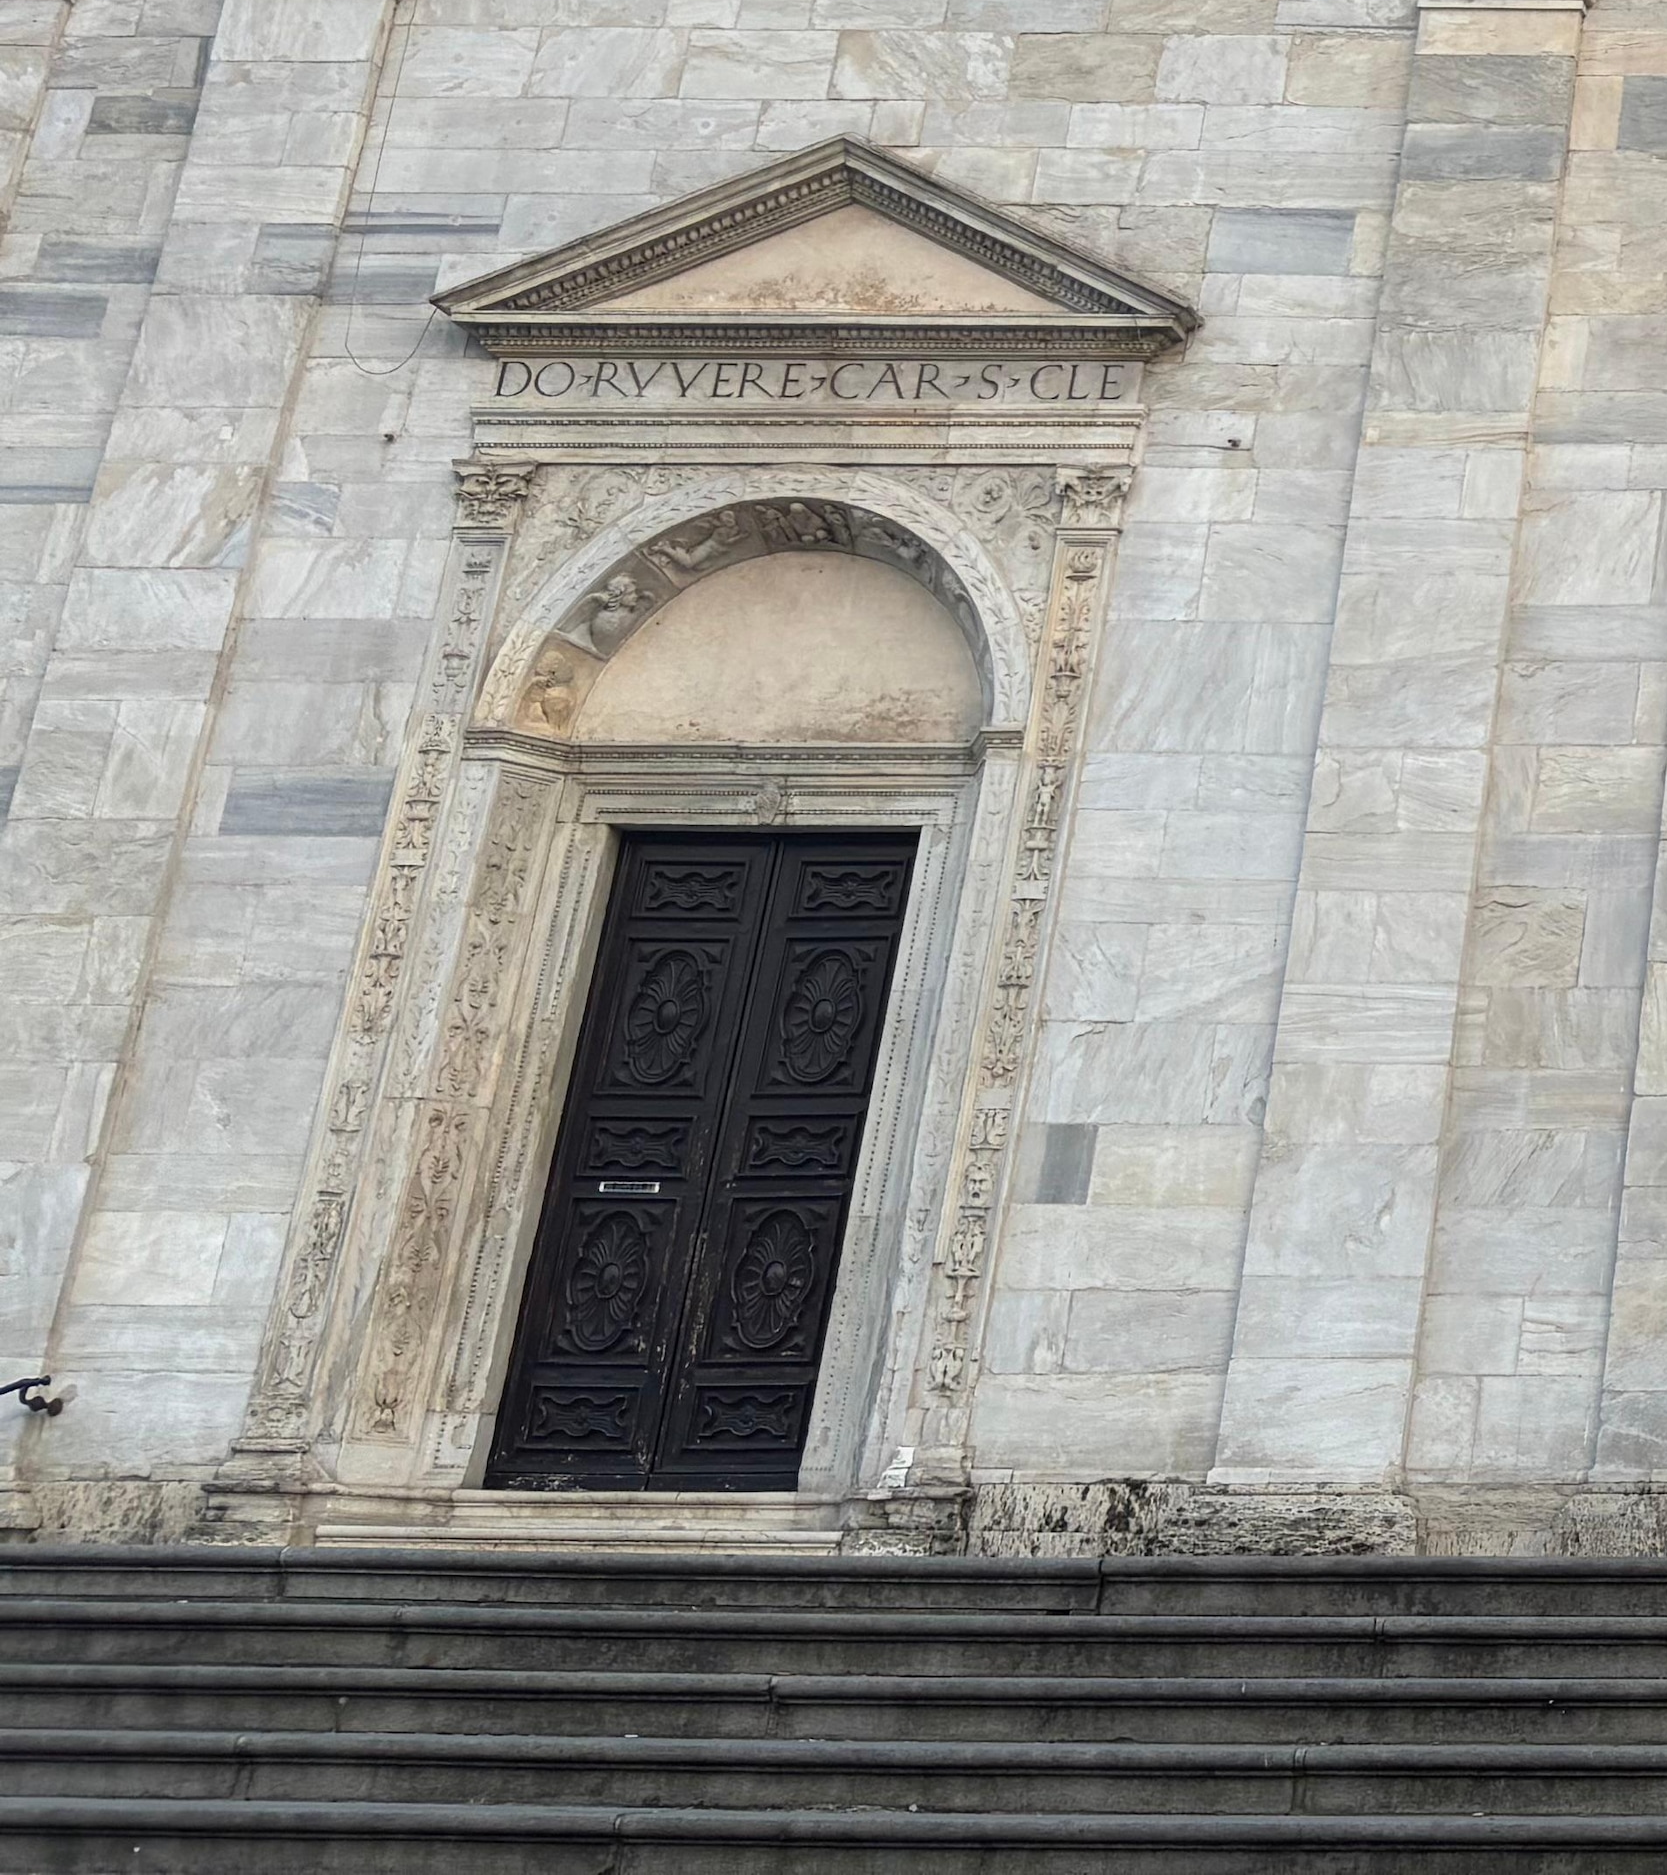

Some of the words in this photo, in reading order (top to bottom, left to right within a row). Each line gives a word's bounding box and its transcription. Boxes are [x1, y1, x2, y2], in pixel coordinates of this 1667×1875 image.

[494, 361, 575, 397] DO
[590, 361, 806, 398] RVVERE
[830, 363, 950, 399] CAR
[977, 364, 1002, 400] S
[1030, 364, 1125, 400] CLE
